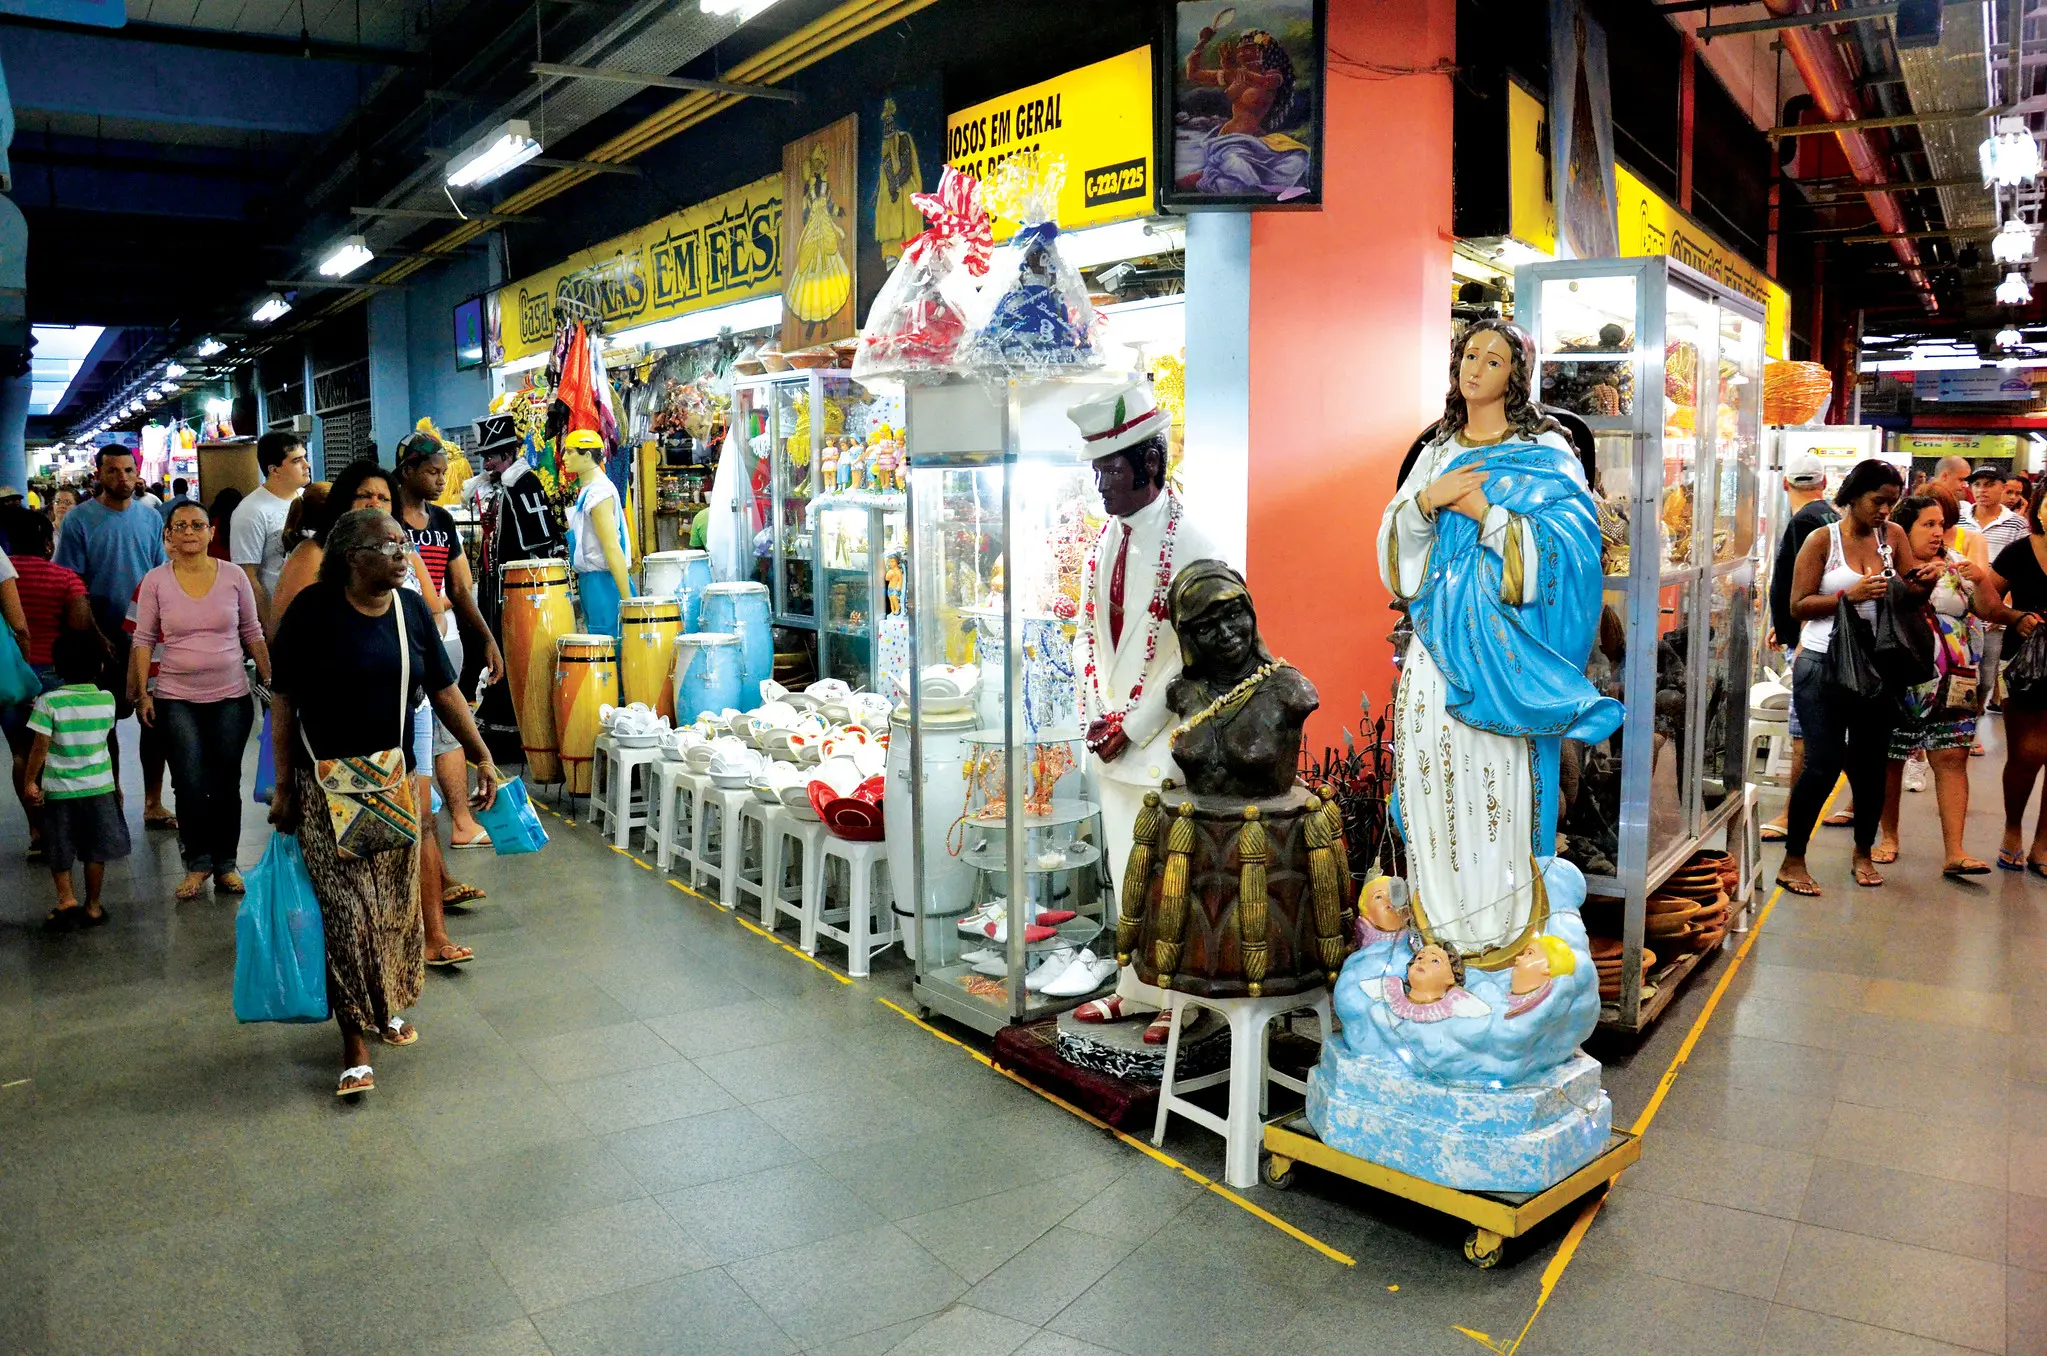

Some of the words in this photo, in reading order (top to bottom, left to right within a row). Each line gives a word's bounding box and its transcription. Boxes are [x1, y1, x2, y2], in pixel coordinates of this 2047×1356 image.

[991, 109, 1011, 148] EM
[1015, 93, 1062, 140] GERAL
[1086, 166, 1144, 198] C-223/225
[519, 289, 553, 343] Casa
[652, 234, 700, 304] EM
